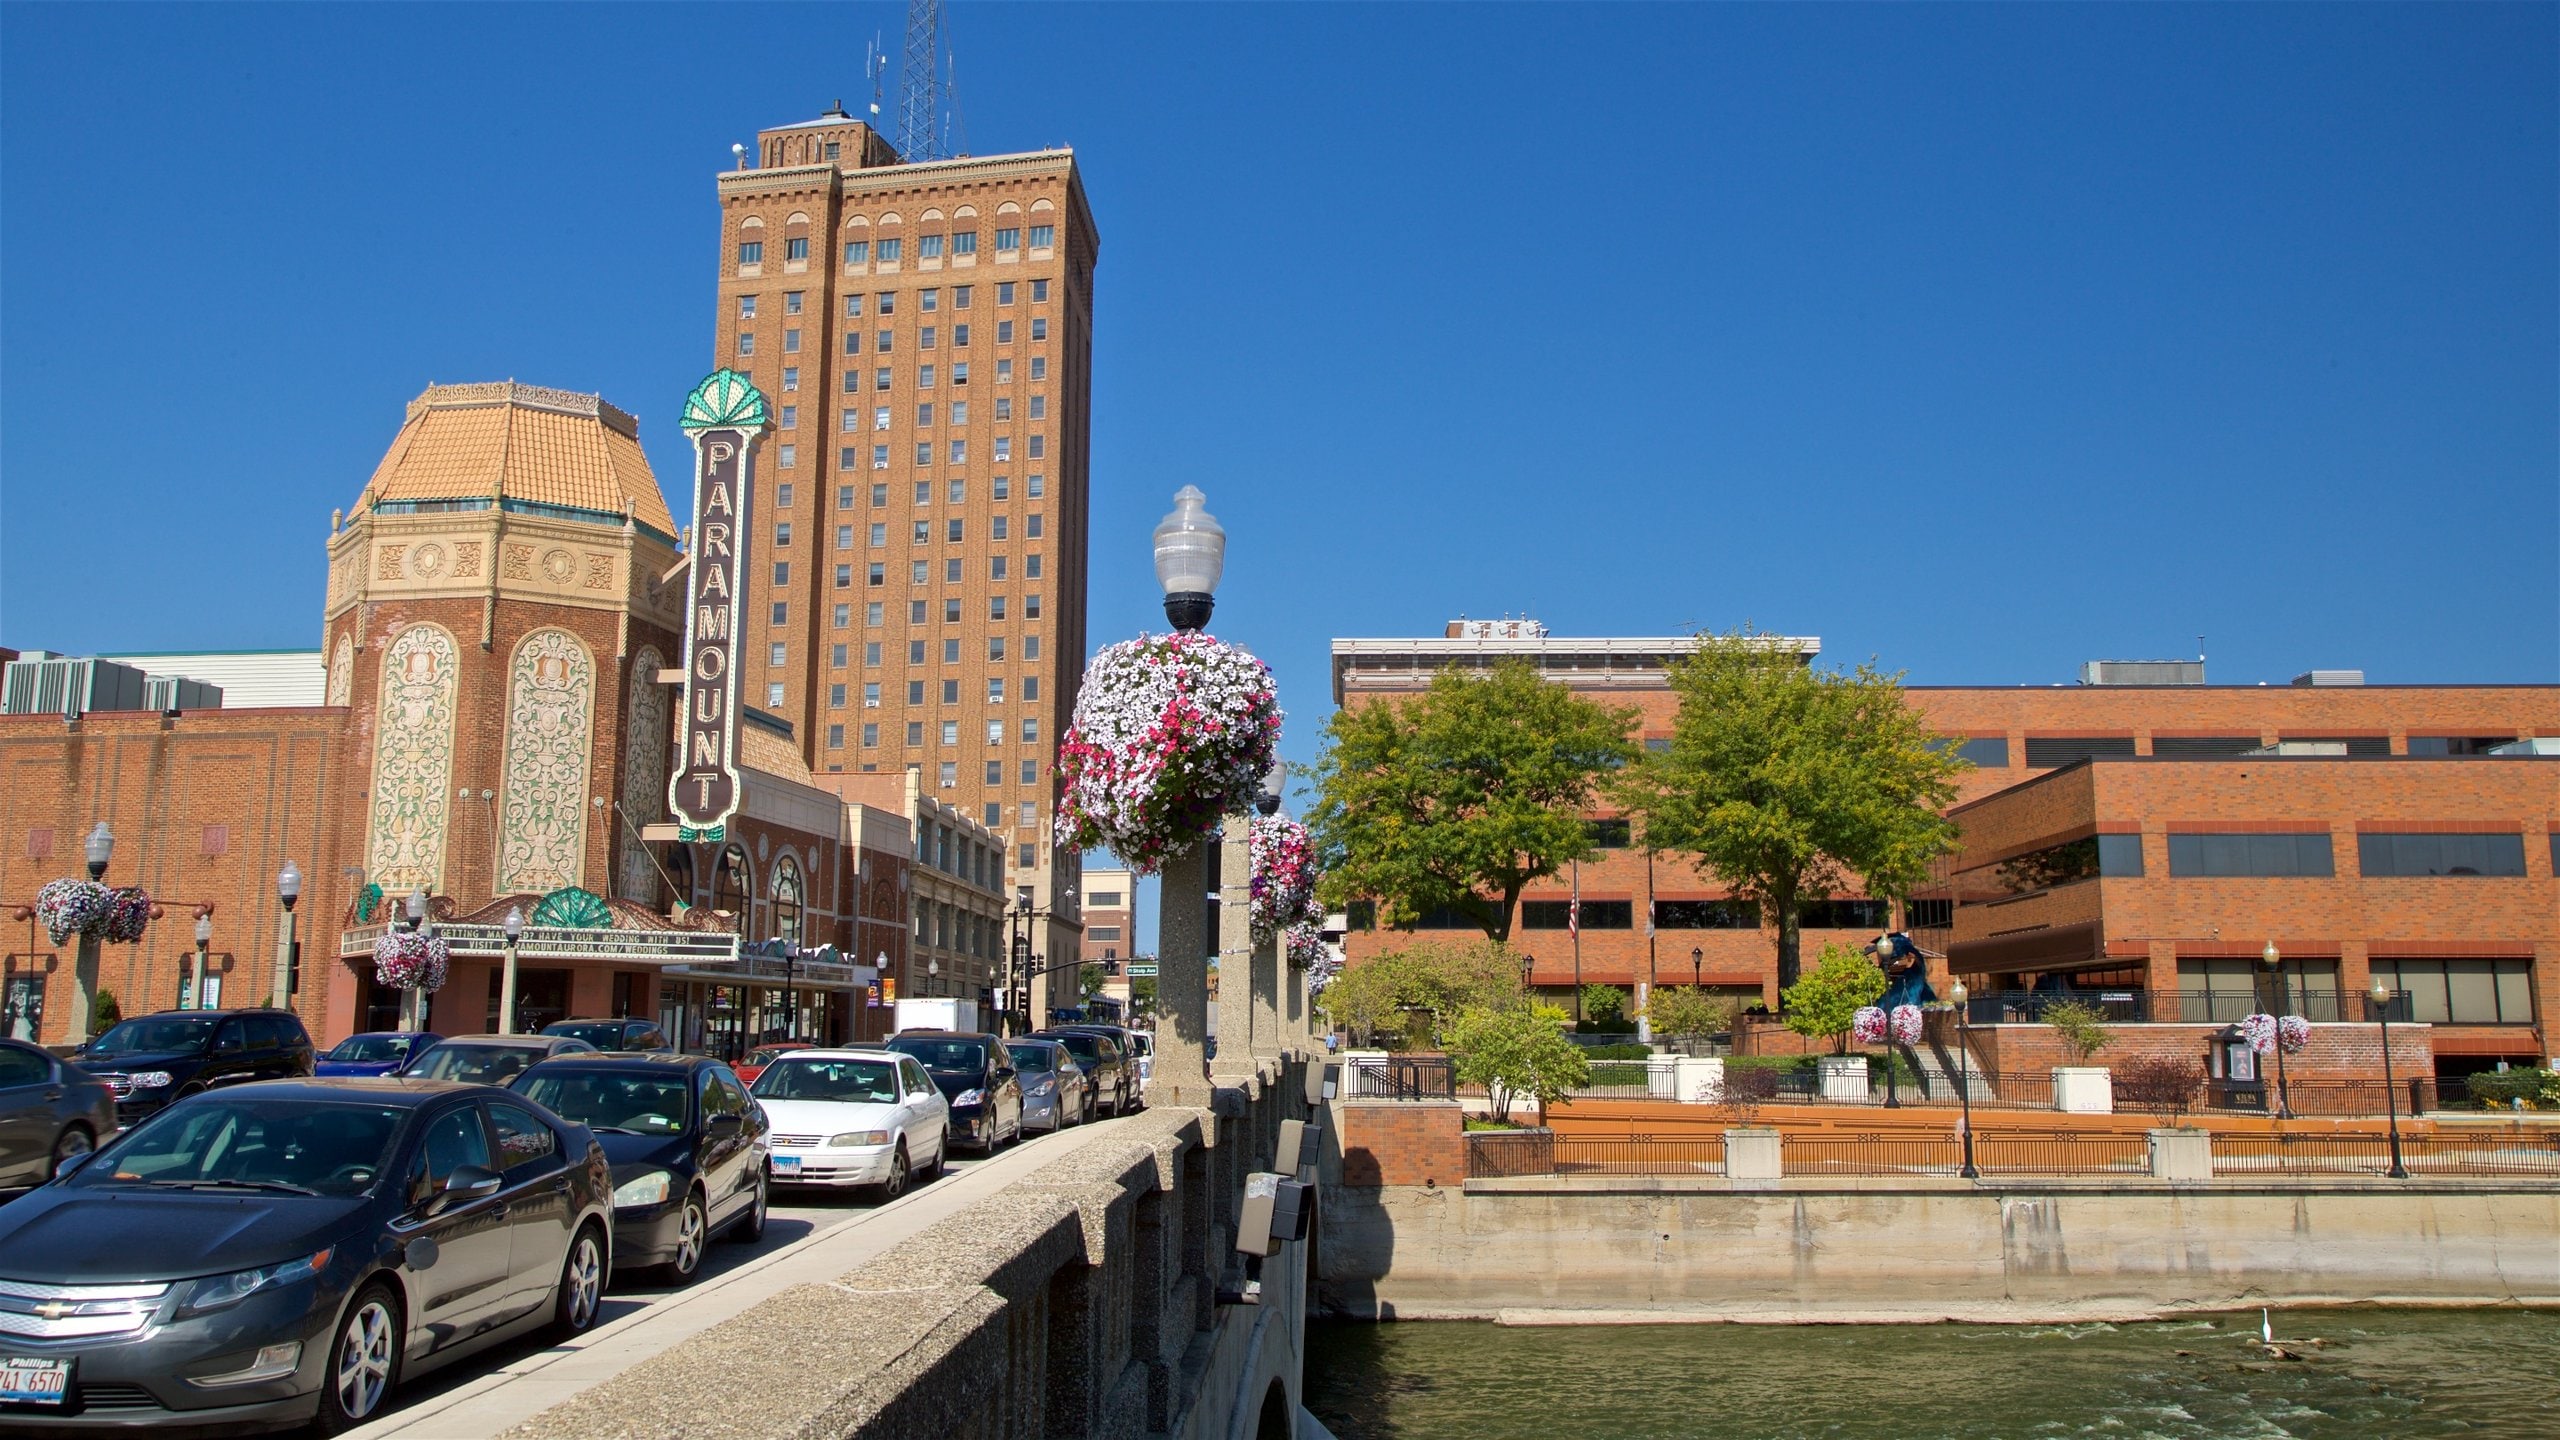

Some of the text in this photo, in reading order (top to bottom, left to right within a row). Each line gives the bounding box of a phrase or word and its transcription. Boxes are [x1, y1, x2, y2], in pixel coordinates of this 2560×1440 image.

[693, 441, 734, 812] PARAMOUNT
[440, 928, 690, 945] GETTING MARED? HAVE YOUR WEDDING WITH US!
[469, 940, 494, 950] VISIT
[10, 1358, 55, 1369] Phillips
[29, 1371, 65, 1393] 6570
